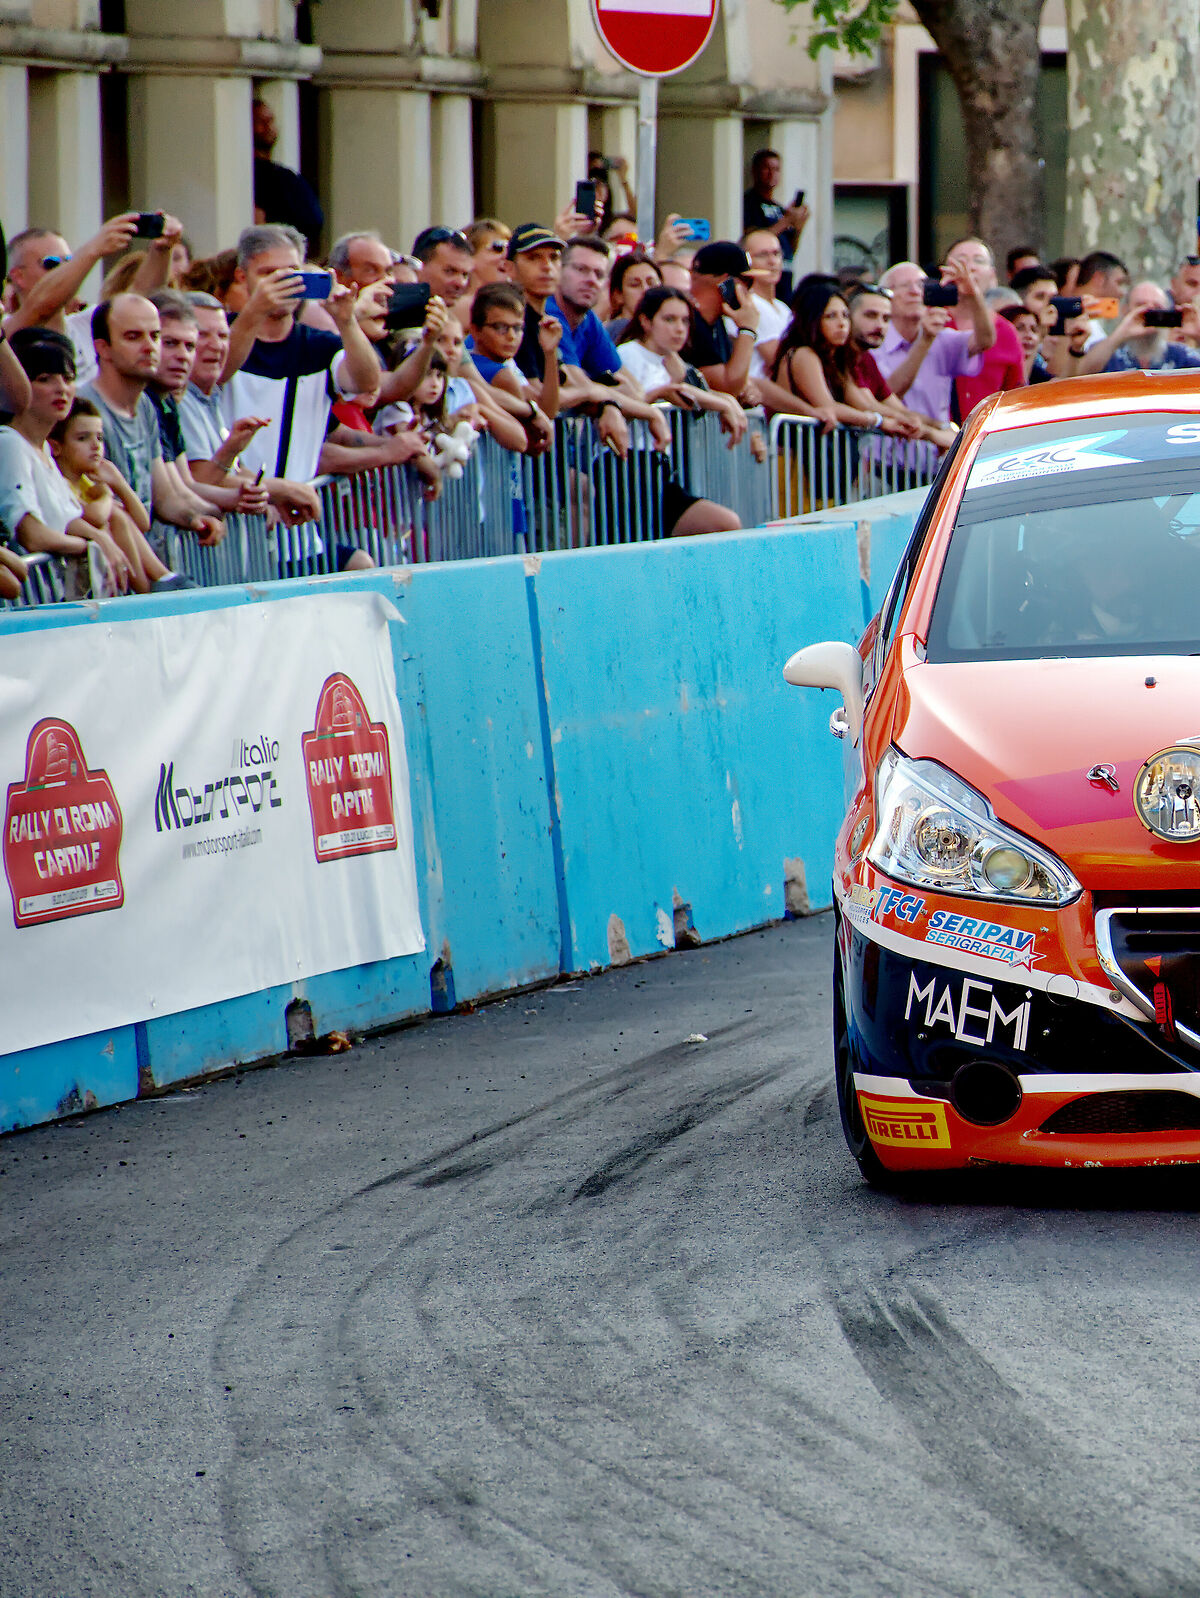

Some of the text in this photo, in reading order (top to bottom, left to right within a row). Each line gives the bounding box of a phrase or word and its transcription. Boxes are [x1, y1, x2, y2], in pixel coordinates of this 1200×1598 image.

[310, 756, 343, 786] RALLY
[9, 809, 51, 843] RALLY
[926, 930, 1016, 961] SERIGRAFIA
[929, 911, 1034, 948] SERIPAV
[864, 1106, 939, 1140] PIRELLI
